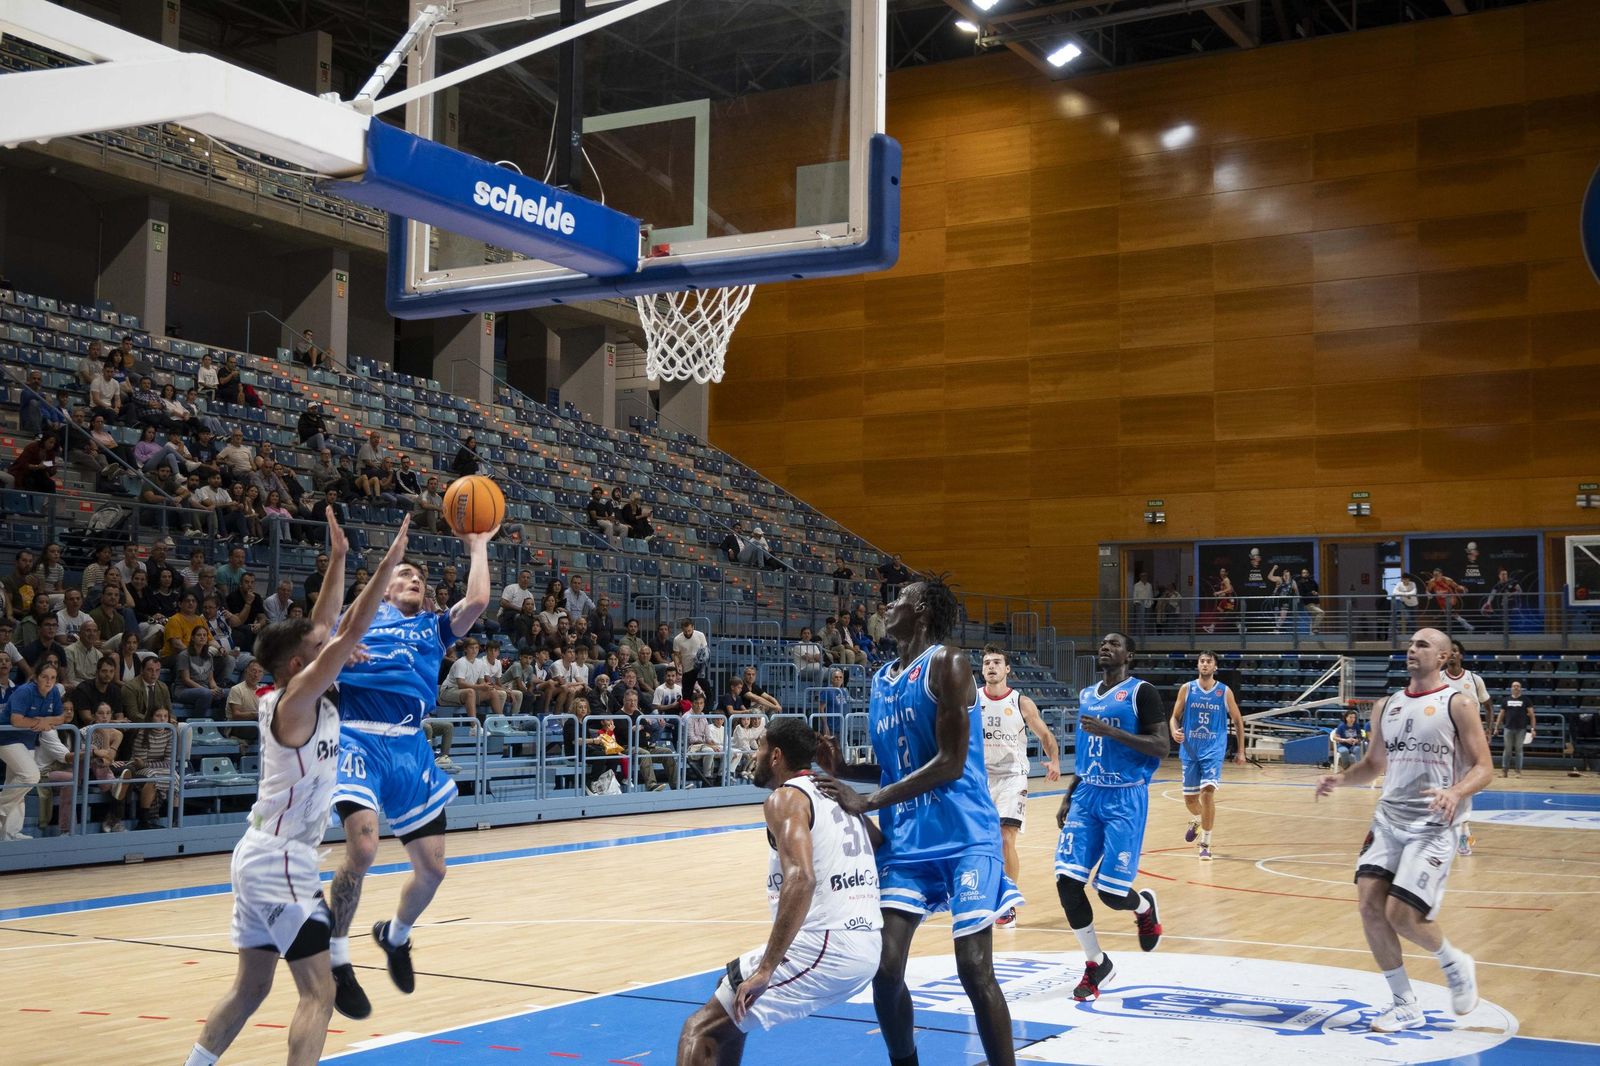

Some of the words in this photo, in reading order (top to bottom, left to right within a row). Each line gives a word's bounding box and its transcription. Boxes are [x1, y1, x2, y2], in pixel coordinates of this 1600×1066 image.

[473, 181, 576, 235] schelde
[987, 716, 1001, 727] 33
[1198, 712, 1210, 724] 55
[1405, 719, 1413, 733] 8
[1088, 735, 1102, 757] 23
[340, 752, 367, 780] 40
[831, 805, 873, 857] 31
[1058, 832, 1073, 854] 23
[1417, 871, 1430, 889] 8
